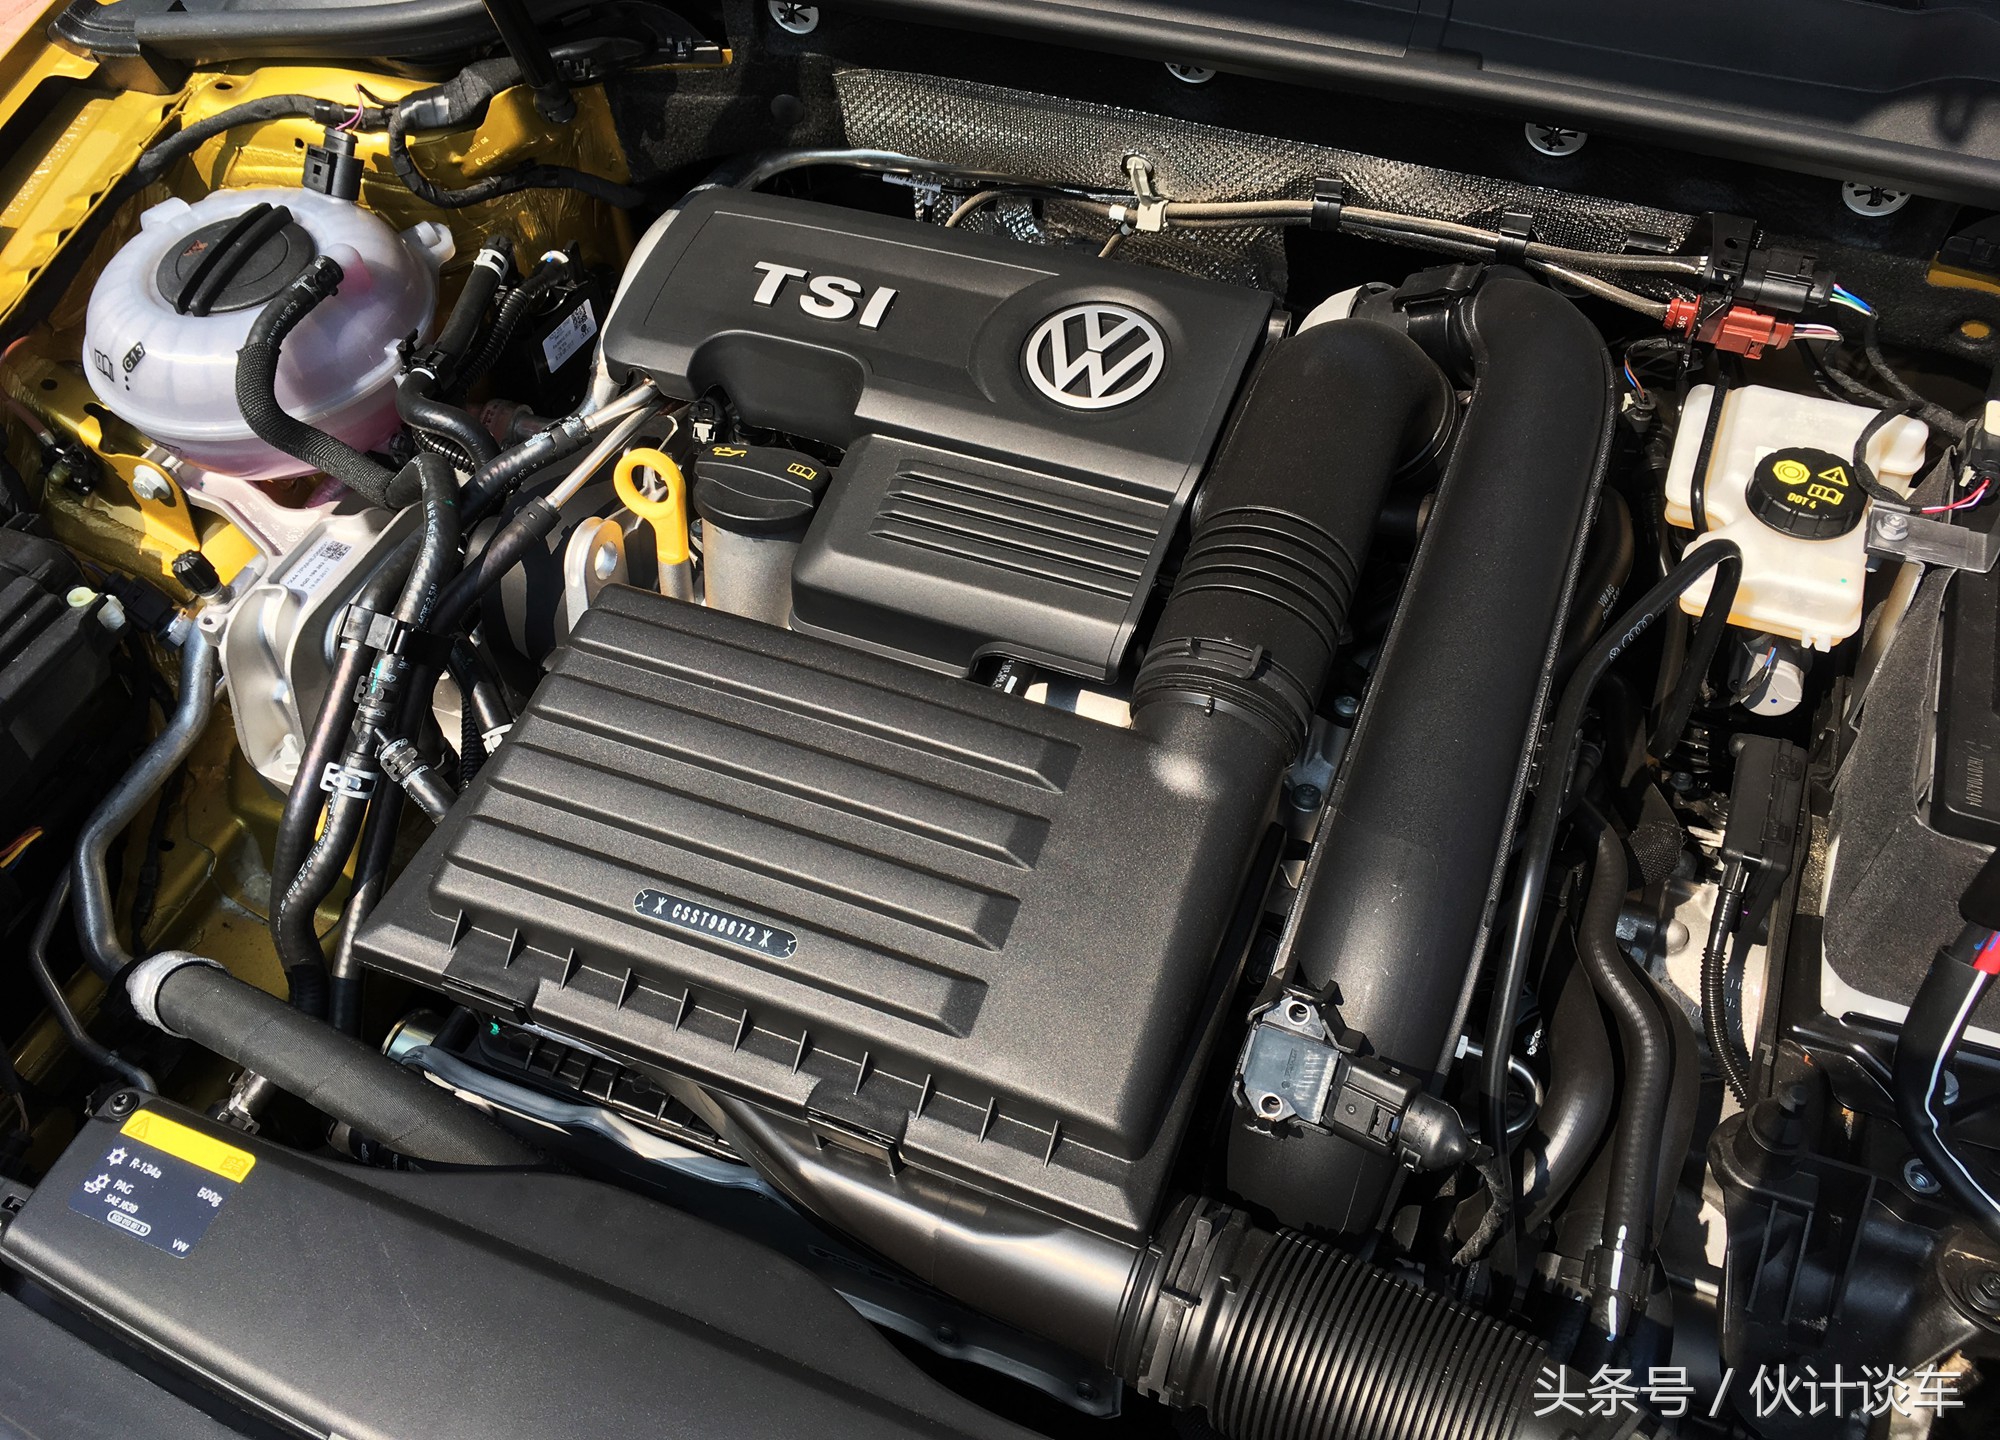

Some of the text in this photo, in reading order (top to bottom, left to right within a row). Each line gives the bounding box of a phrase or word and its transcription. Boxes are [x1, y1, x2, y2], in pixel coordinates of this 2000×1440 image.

[753, 260, 898, 329] TSI
[123, 344, 144, 371] G13
[1786, 492, 1810, 506] DOT
[672, 903, 756, 942] CSST98672
[128, 1157, 162, 1179] R-134a
[104, 1193, 120, 1207] SAE
[112, 1179, 223, 1207] PAG 500g
[172, 1238, 190, 1253] VW
